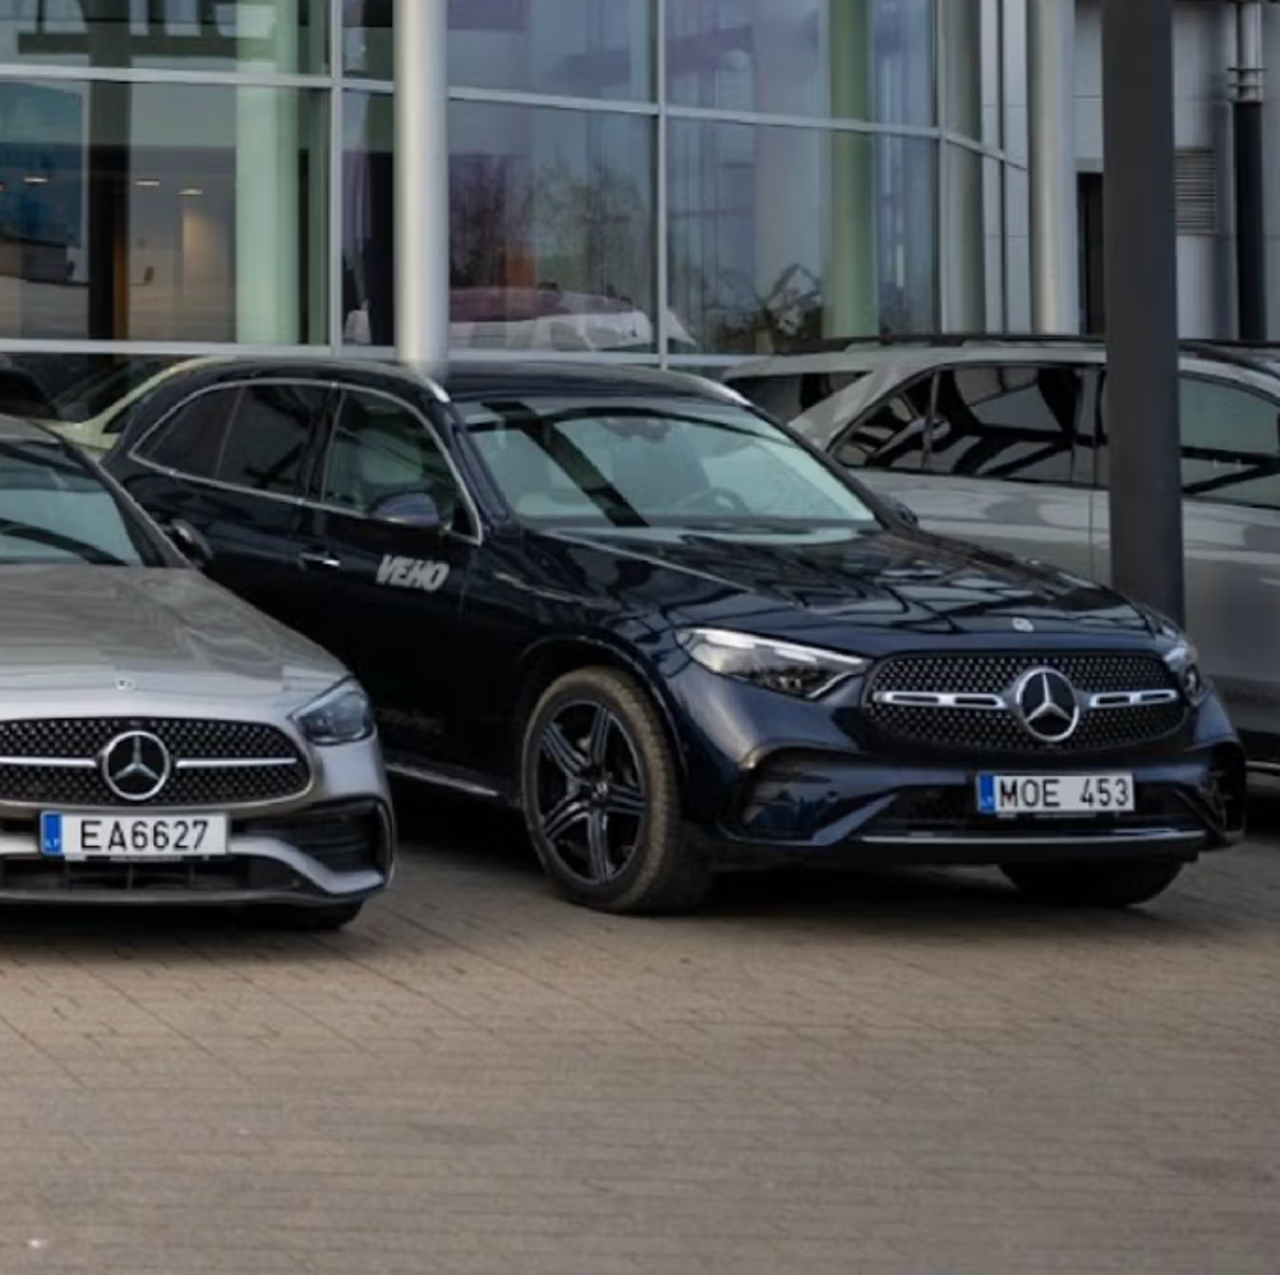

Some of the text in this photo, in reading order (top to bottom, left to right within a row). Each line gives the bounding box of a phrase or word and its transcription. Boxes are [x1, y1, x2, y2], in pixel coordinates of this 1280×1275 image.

[1000, 777, 1130, 808] MOE 453
[80, 820, 209, 851] EA6627
